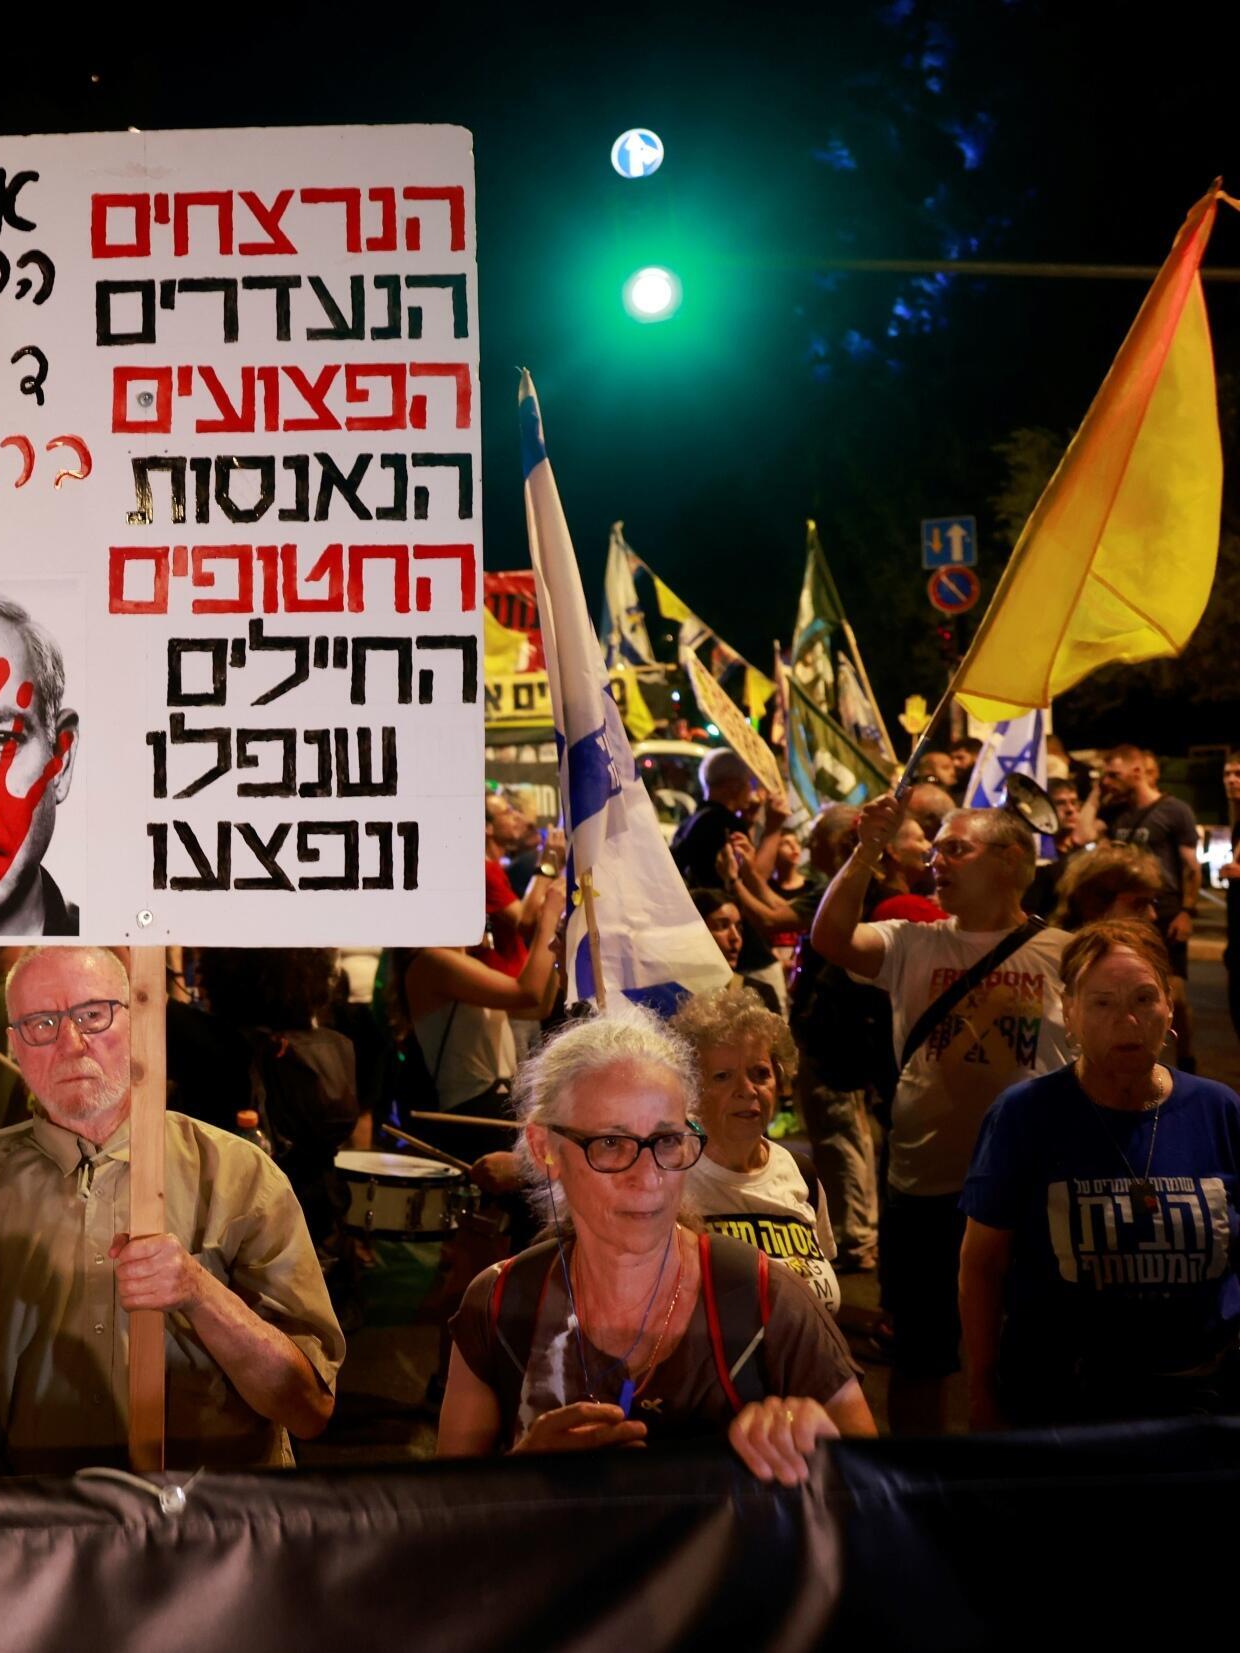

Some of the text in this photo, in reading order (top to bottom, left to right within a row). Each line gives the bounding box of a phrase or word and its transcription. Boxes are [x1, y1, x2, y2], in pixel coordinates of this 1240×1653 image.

[91, 185, 466, 259] הנרצחים
[96, 273, 469, 347] הנעדרים
[111, 362, 471, 434] הפצועים
[125, 452, 473, 525] הנאנסות
[108, 543, 477, 615] החטופים
[166, 617, 478, 707] החיילים
[145, 712, 399, 800] שנפלו
[146, 819, 419, 893] ונפצעו
[932, 967, 1045, 989] FRDOM
[1077, 1194, 1208, 1253] הבית
[1079, 1253, 1208, 1292] המשותף
